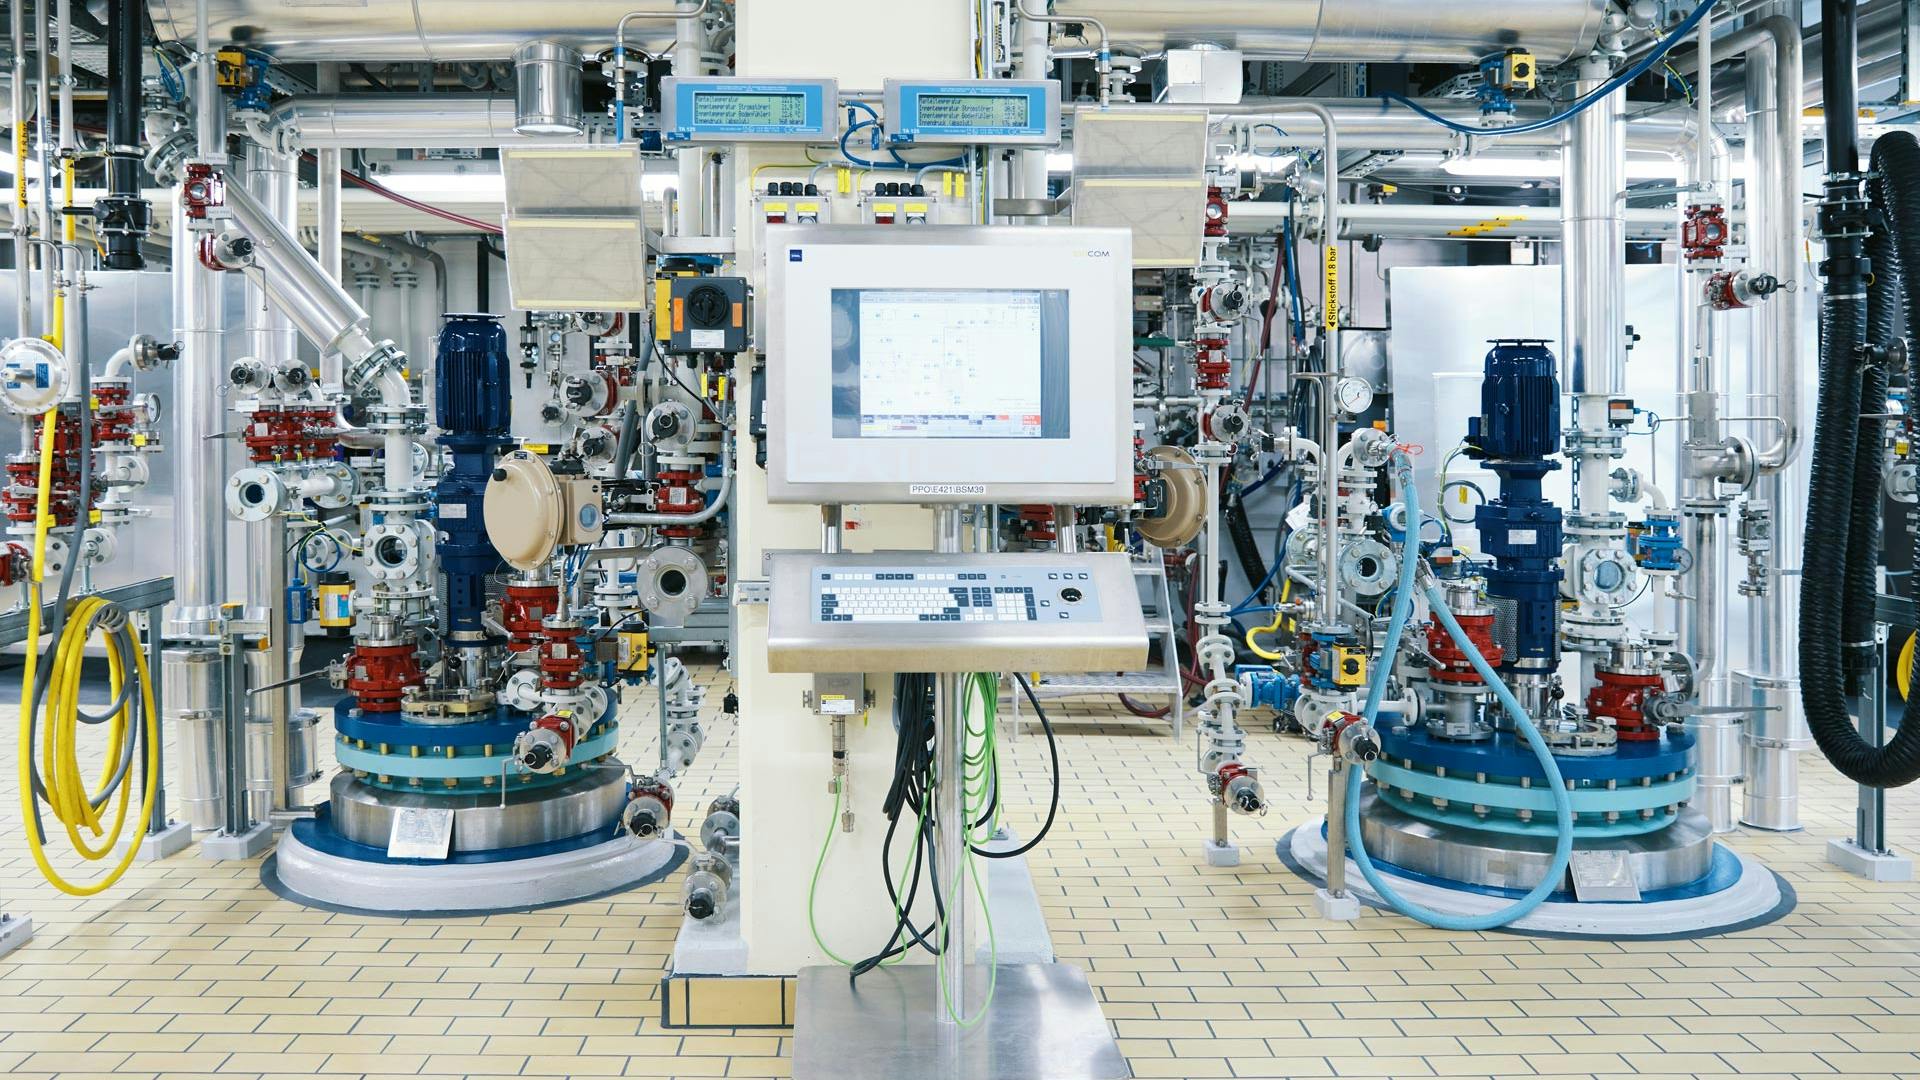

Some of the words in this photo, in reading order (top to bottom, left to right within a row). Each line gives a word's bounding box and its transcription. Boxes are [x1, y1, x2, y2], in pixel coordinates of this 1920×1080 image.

[1328, 247, 1337, 262] bar
[1328, 279, 1337, 321] Stickstoff
[912, 485, 985, 494] PPO\E421\BSM39
